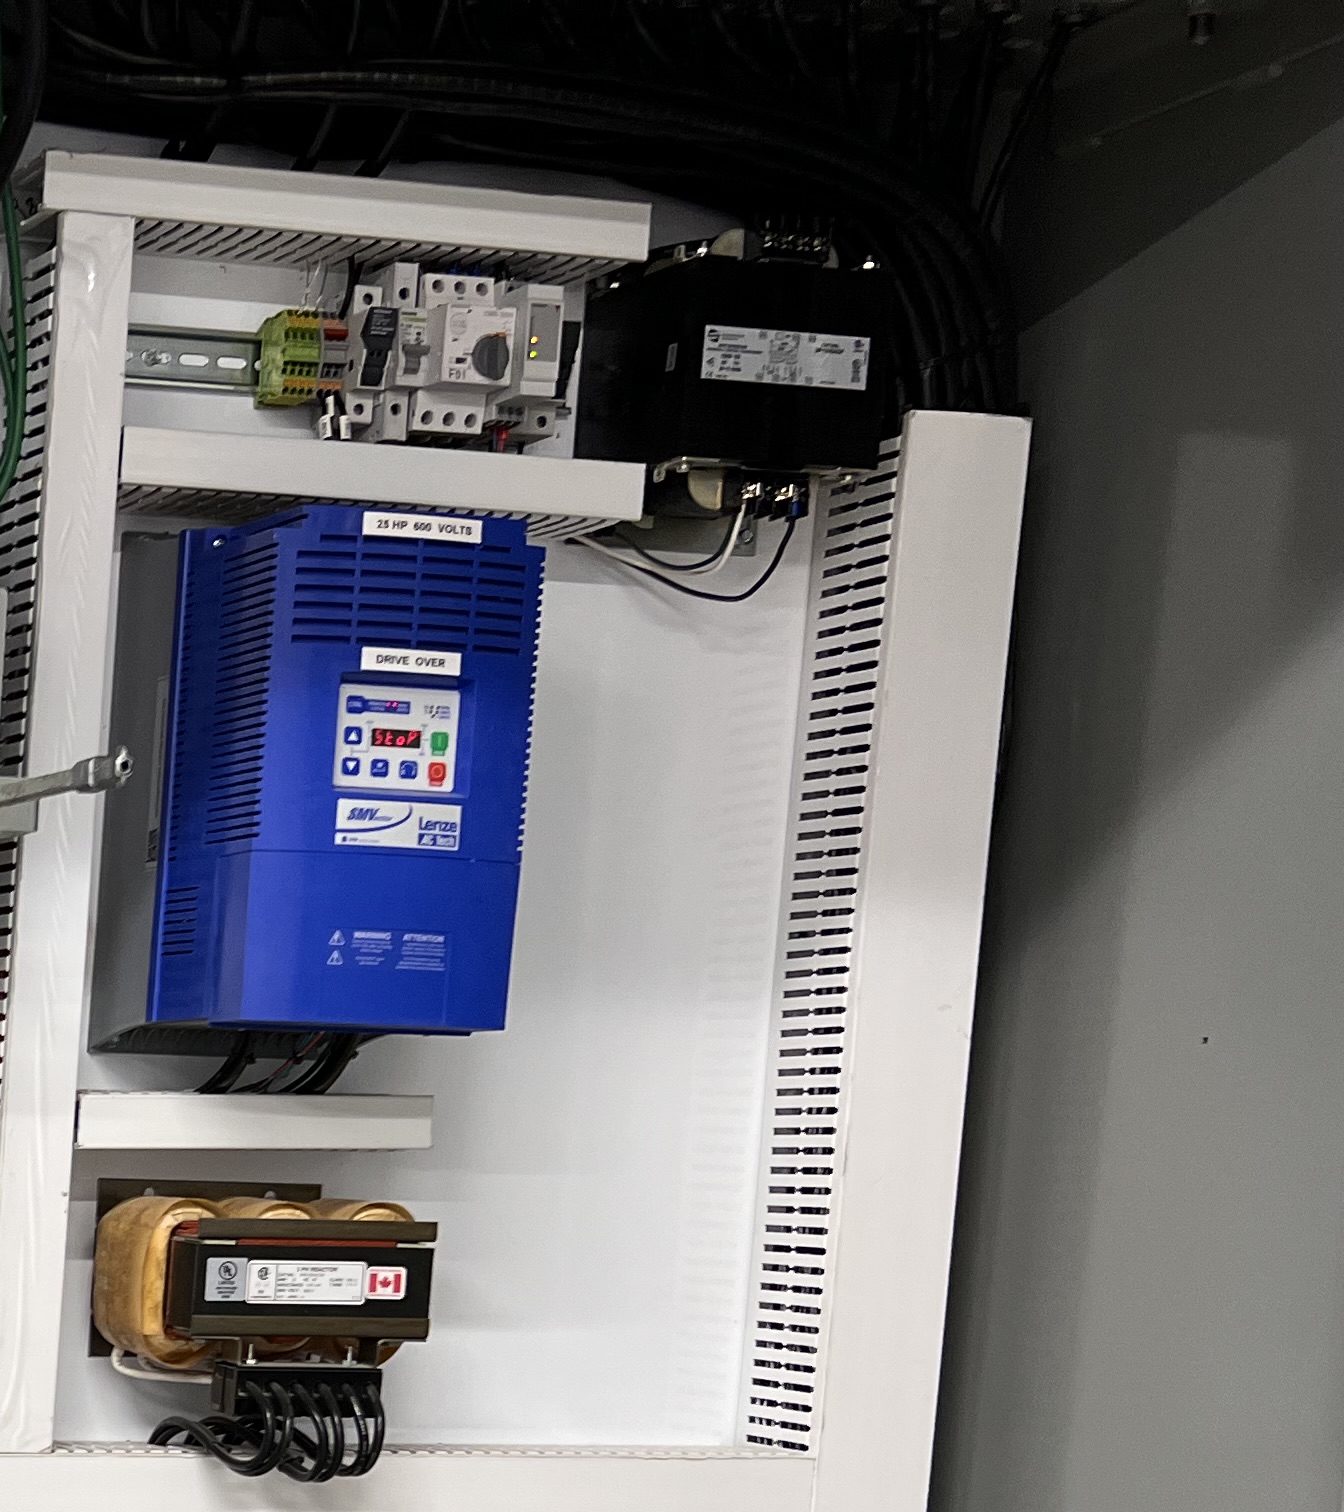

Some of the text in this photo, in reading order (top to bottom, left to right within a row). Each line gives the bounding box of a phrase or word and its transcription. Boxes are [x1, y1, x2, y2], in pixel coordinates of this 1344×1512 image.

[438, 523, 472, 536] VOLTS
[376, 654, 446, 668] DRIVE OVER
[418, 816, 457, 833] Lenze
